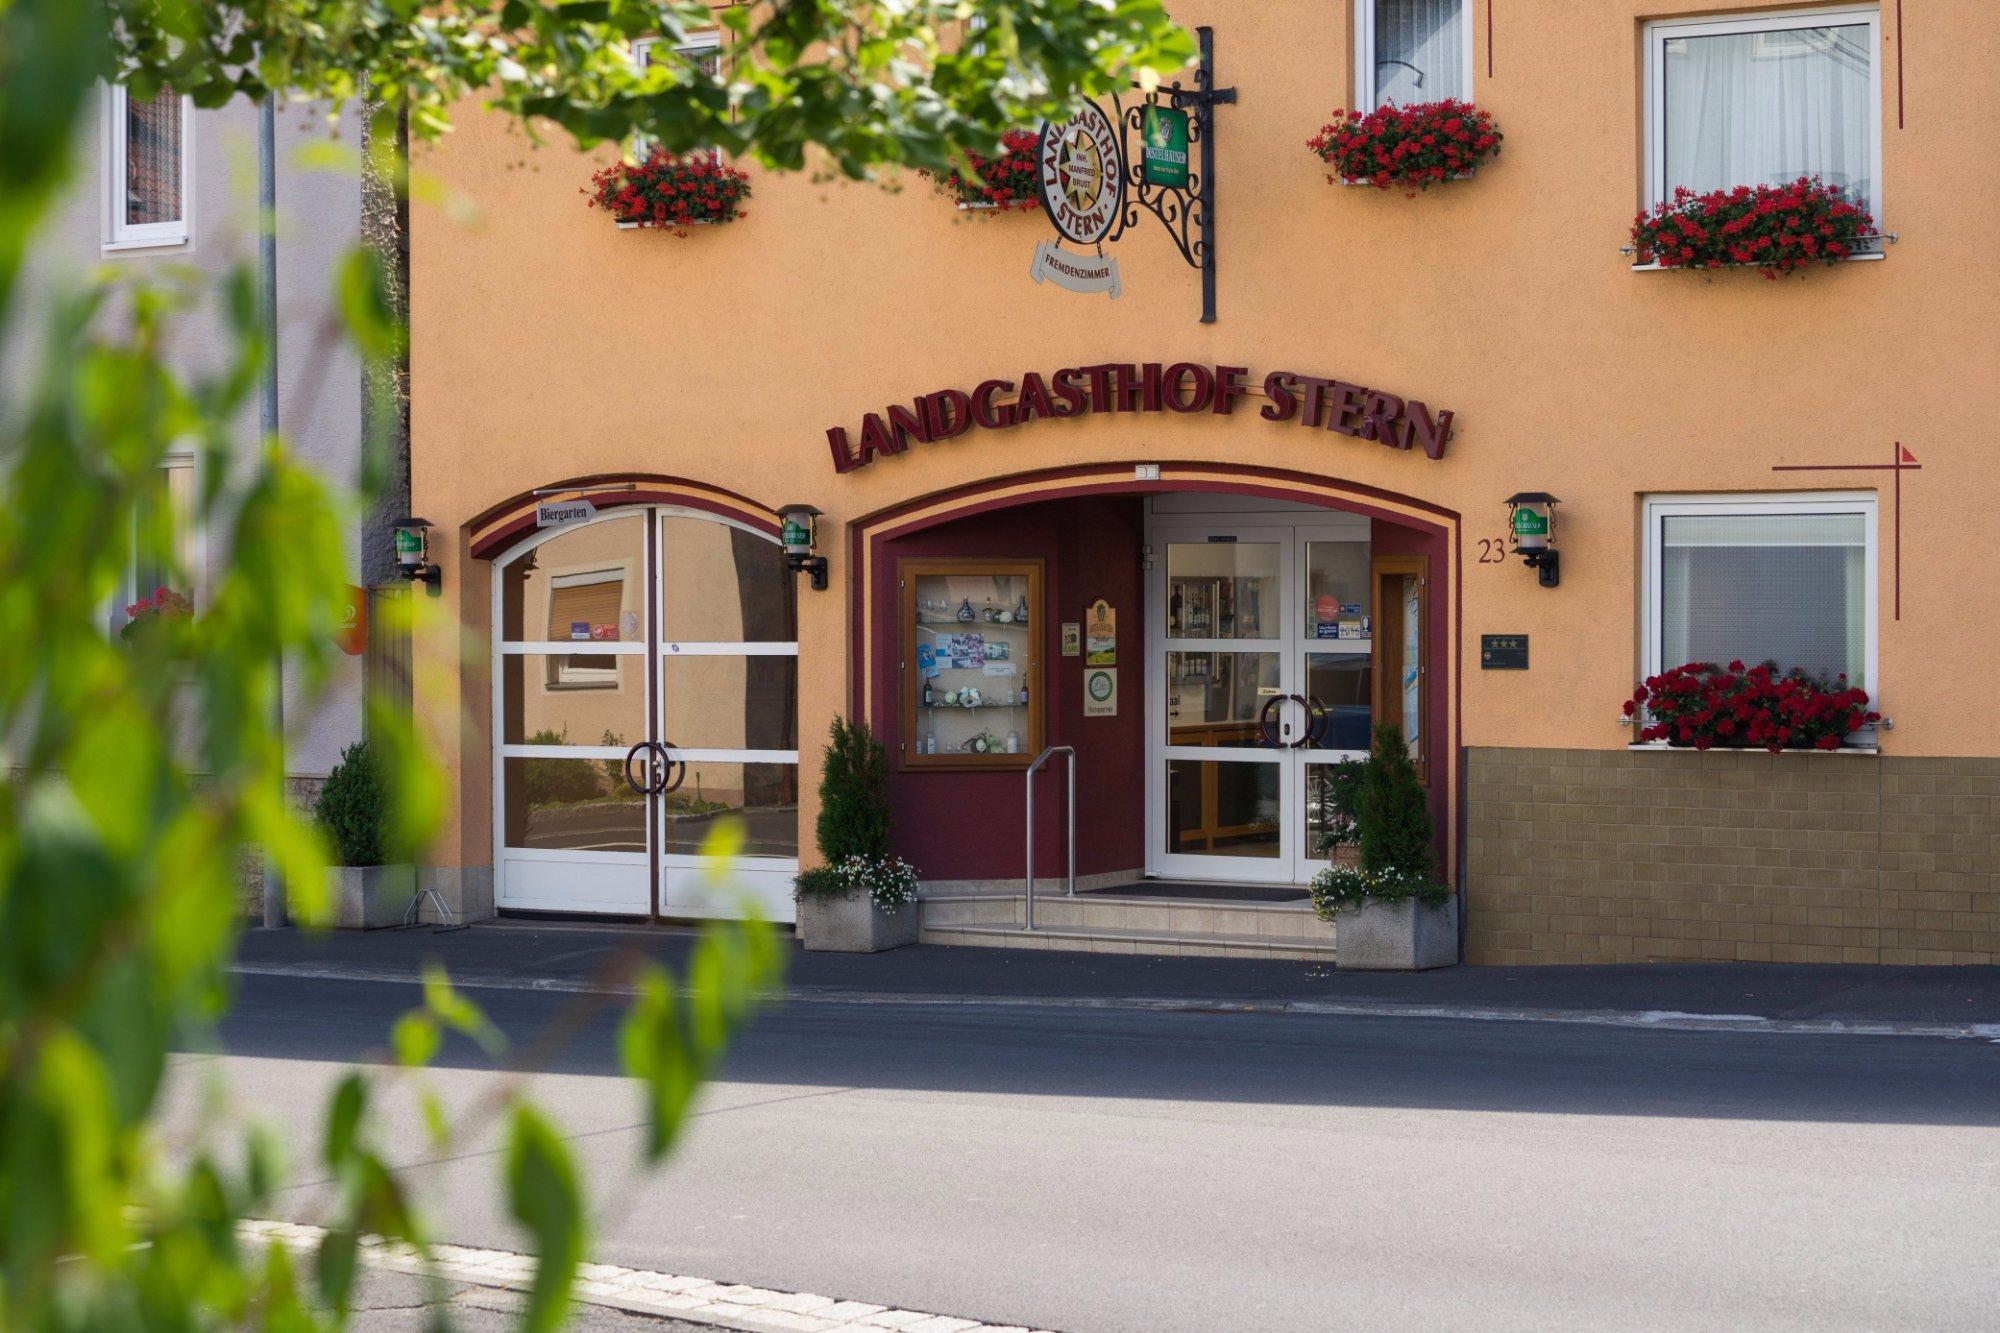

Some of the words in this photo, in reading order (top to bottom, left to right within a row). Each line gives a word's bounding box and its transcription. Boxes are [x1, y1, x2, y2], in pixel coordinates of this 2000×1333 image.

[1068, 165, 1095, 176] MANFRED
[1072, 178, 1091, 188] BRUST
[1057, 202, 1105, 235] STERN
[1045, 254, 1110, 278] FREMDENZIMMER
[826, 362, 1249, 474] LANDGASTHOF
[1260, 371, 1454, 460] STERN
[540, 508, 587, 523] Biergarten
[1477, 538, 1505, 563] 23
[1169, 695, 1181, 706] aal
